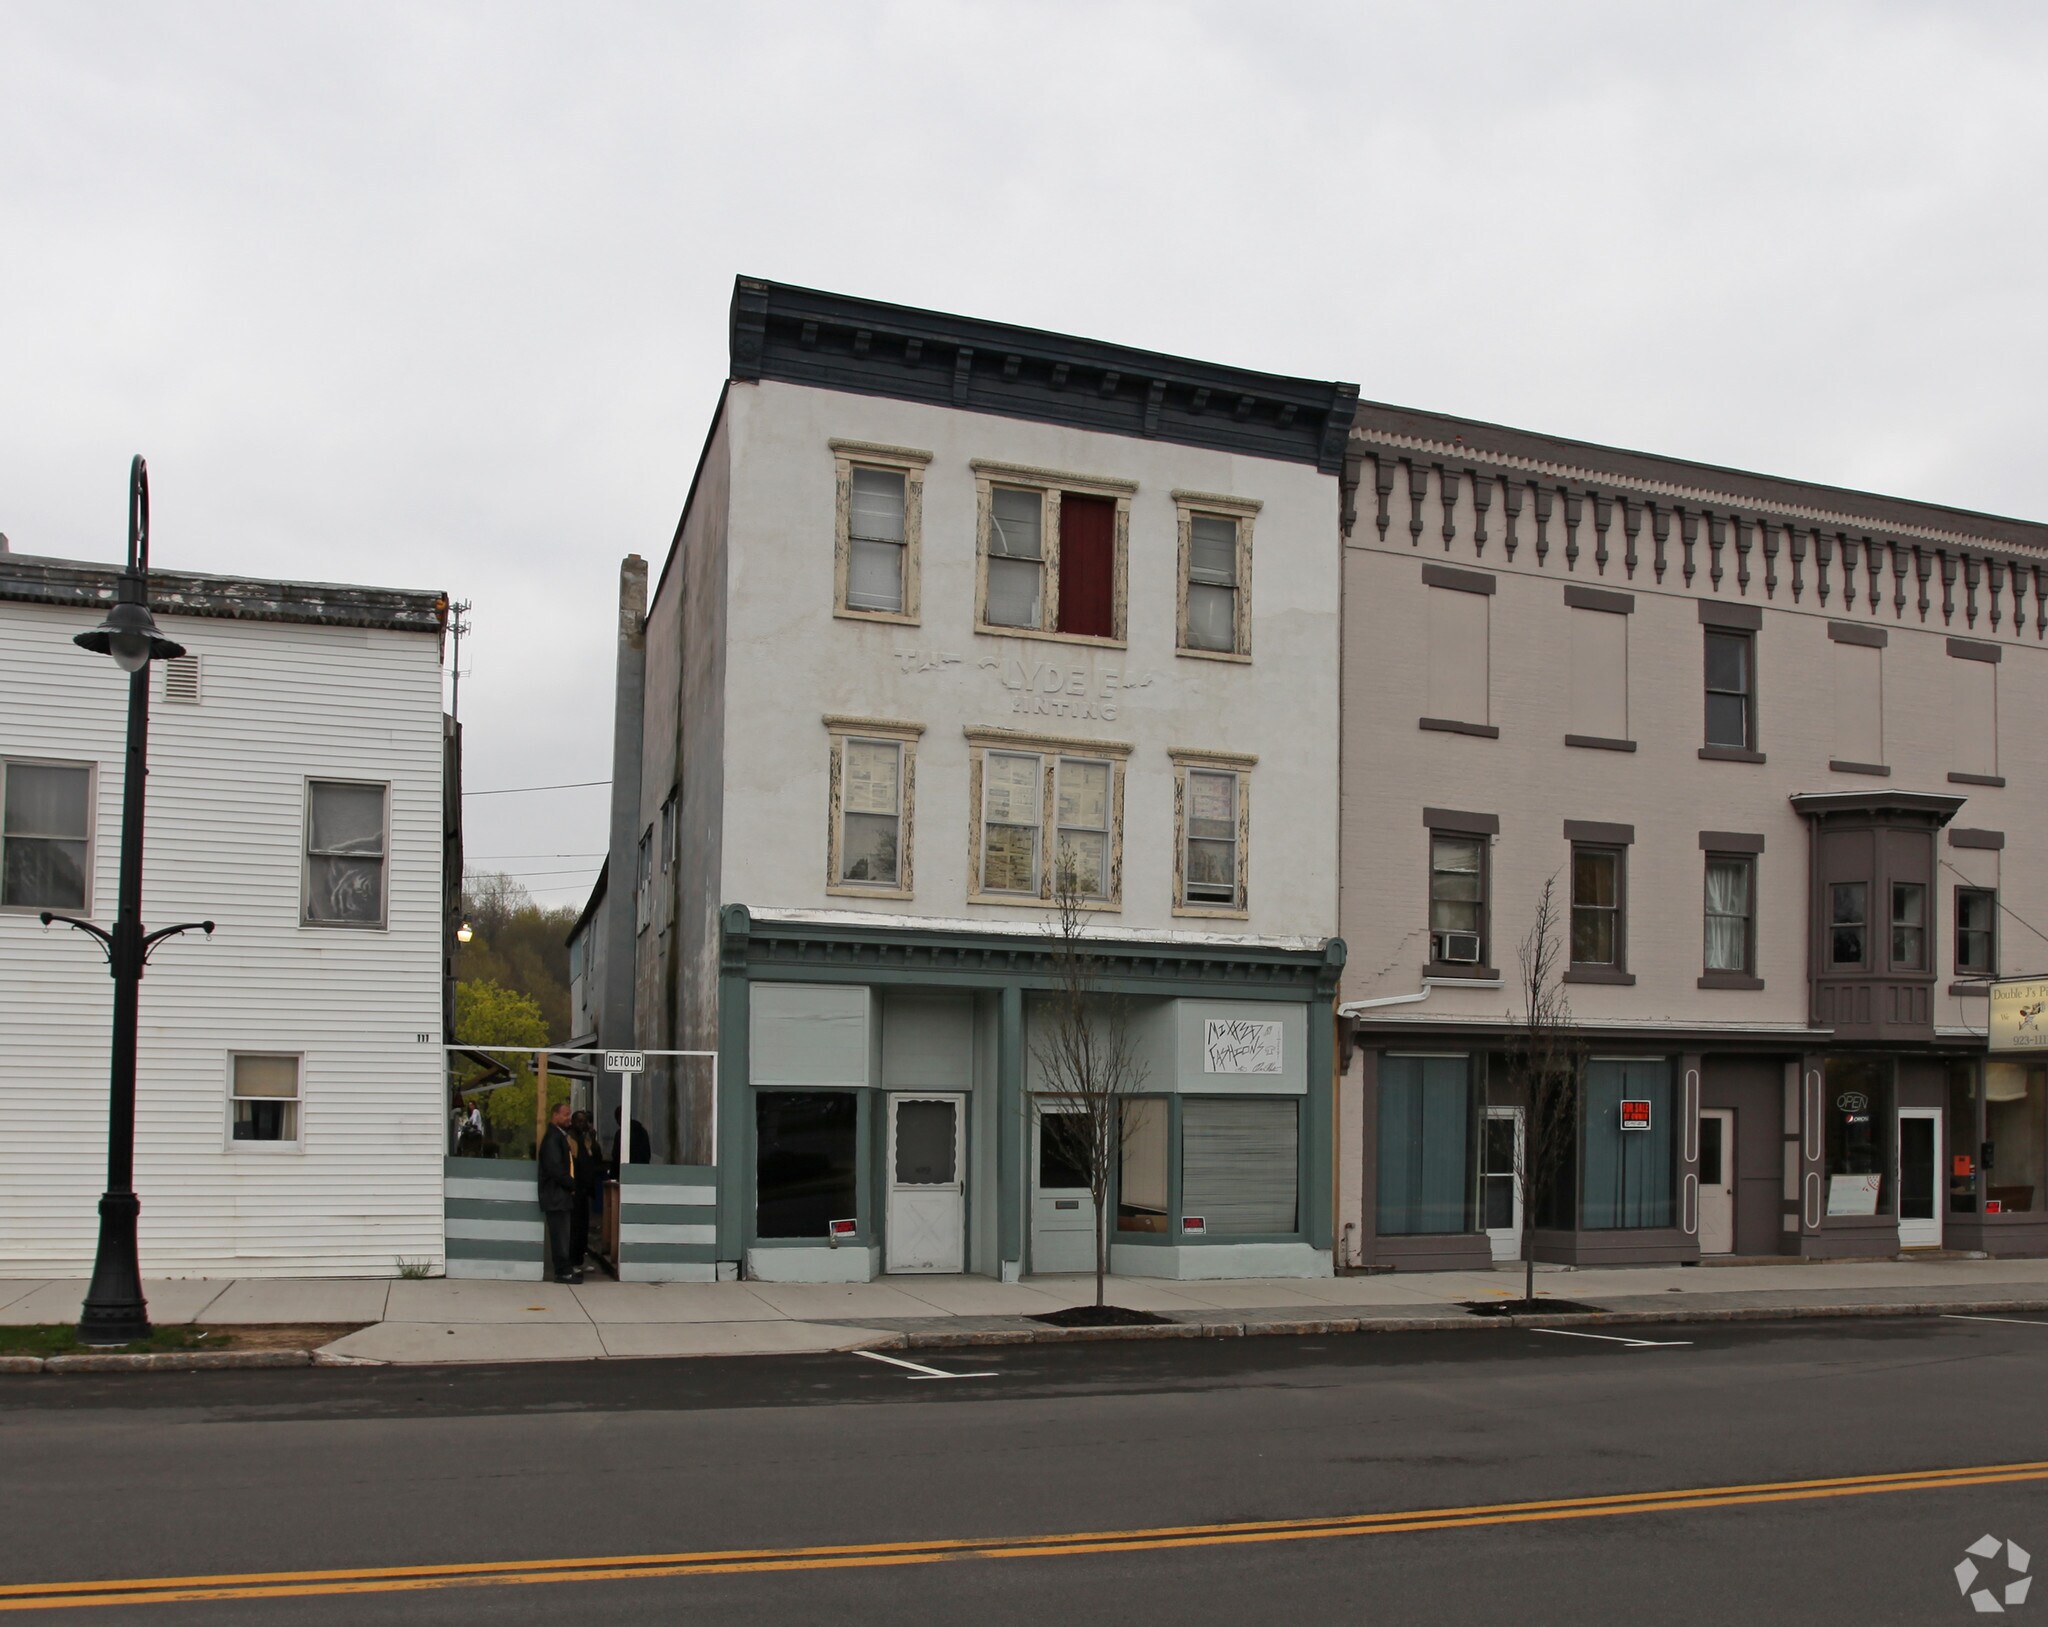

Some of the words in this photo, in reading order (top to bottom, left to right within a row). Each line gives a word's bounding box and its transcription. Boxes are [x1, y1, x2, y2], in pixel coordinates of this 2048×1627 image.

[1993, 987, 2022, 1001] Double
[2025, 986, 2036, 998] J's
[417, 1033, 430, 1043] 111
[608, 1055, 642, 1067] DETOUR
[1836, 1094, 1869, 1110] OPEN
